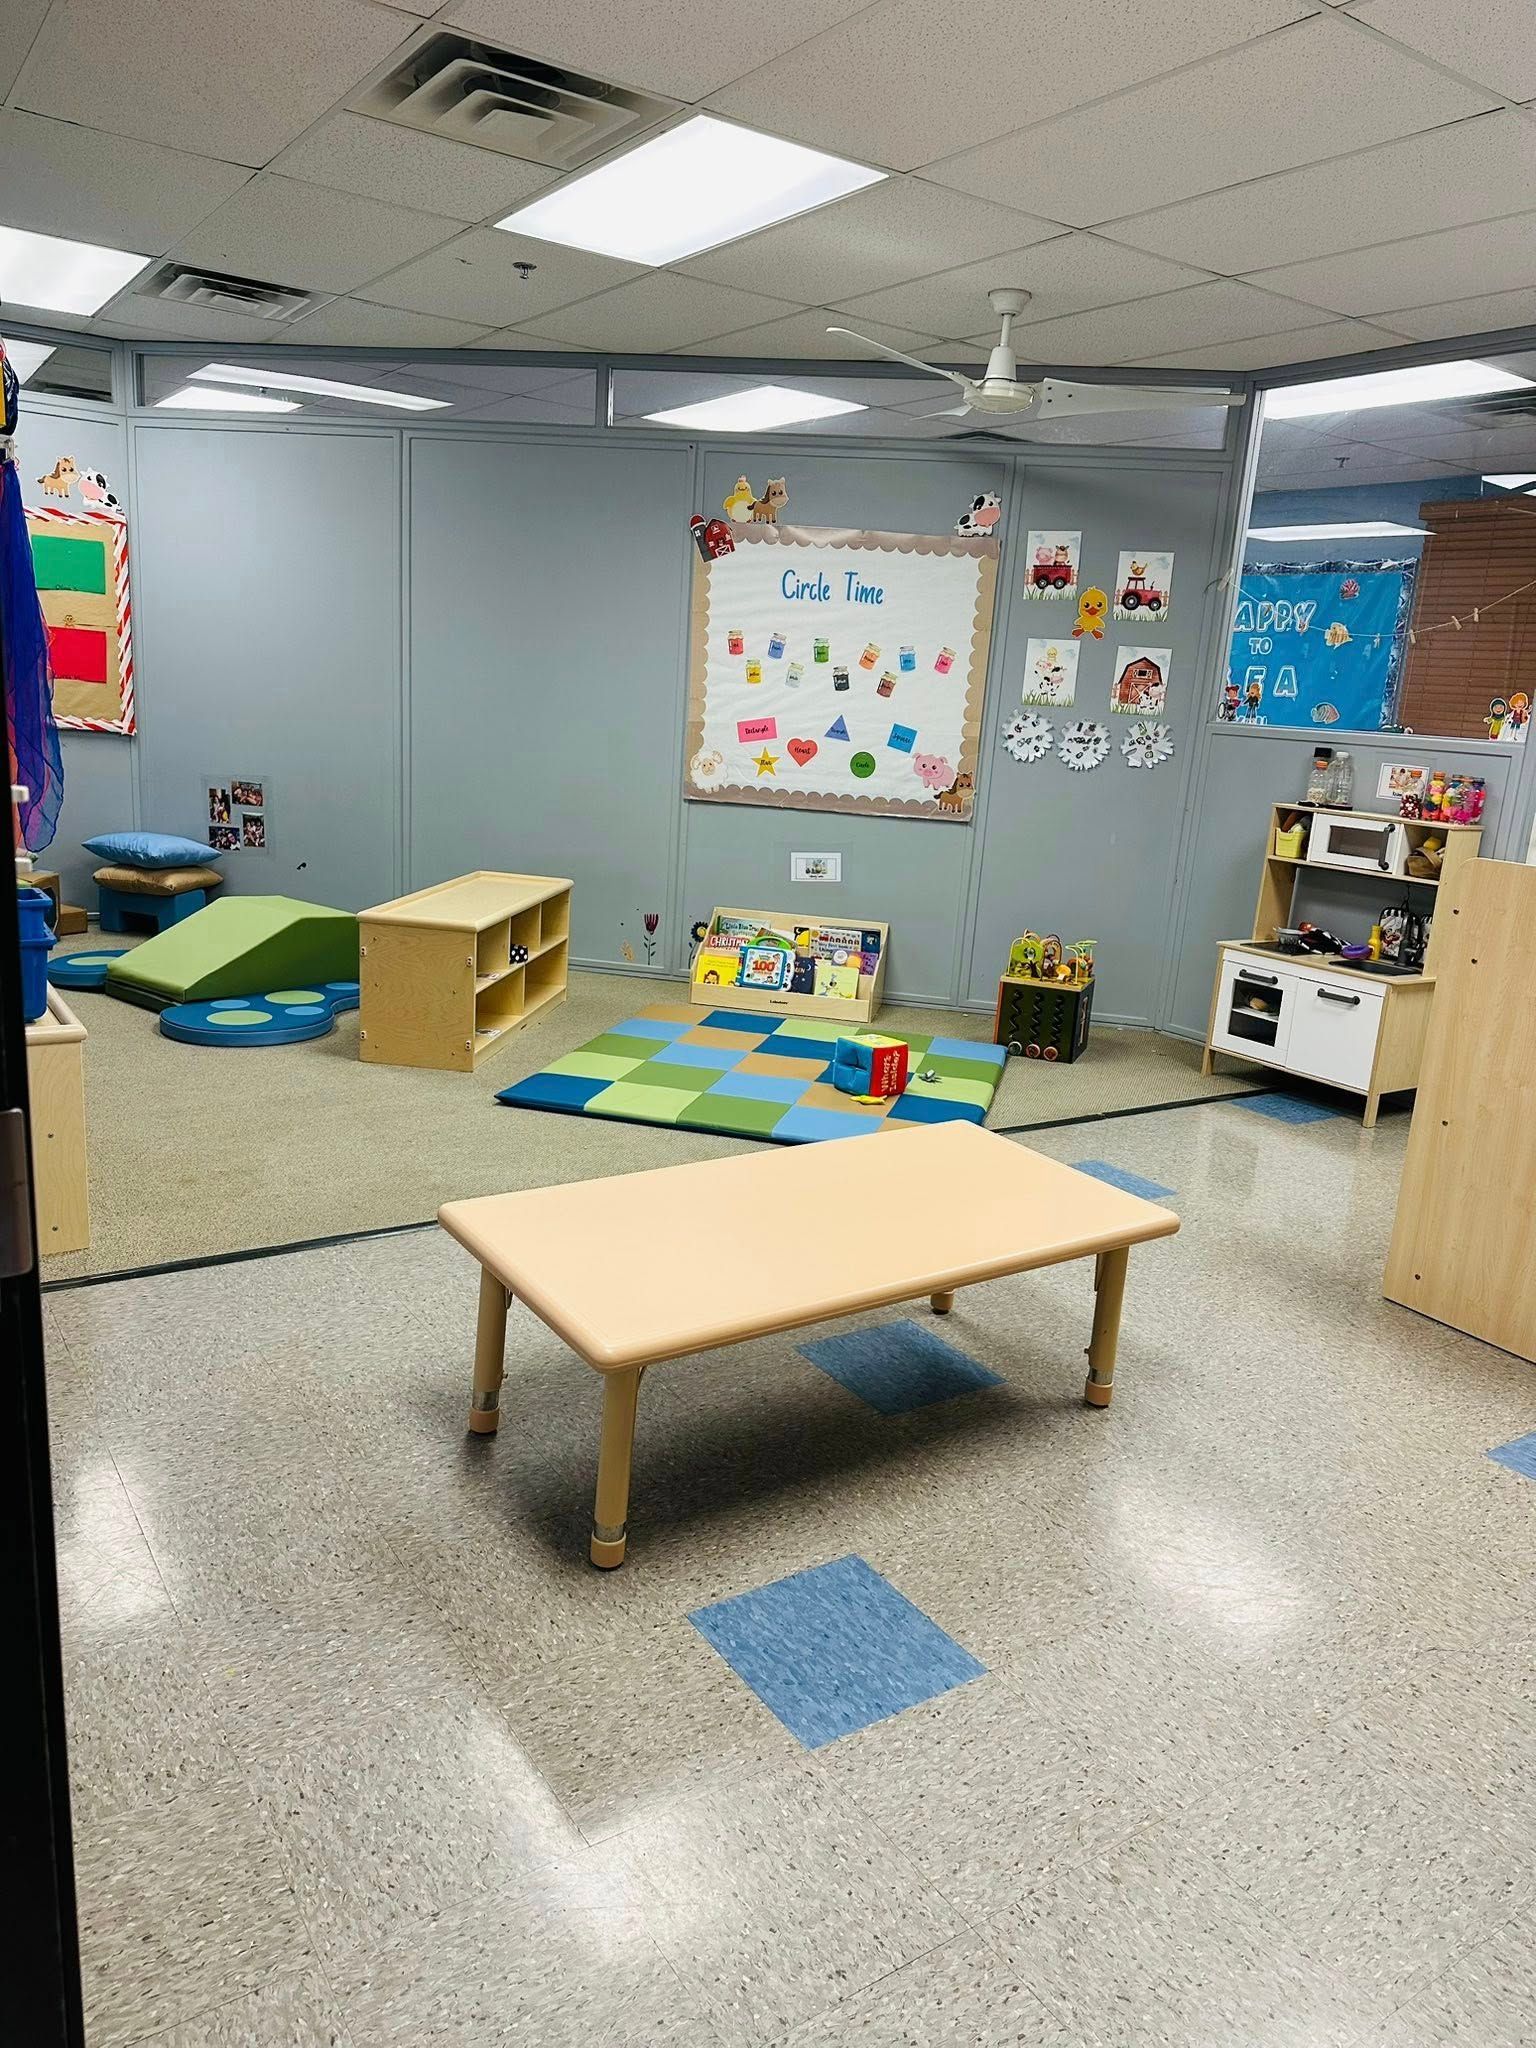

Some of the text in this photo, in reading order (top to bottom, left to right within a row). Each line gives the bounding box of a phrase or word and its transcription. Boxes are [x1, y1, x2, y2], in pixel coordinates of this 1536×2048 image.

[781, 569, 884, 605] Circle Time
[1249, 637, 1273, 655] TO
[794, 746, 811, 755] Heart
[752, 960, 775, 972] 100
